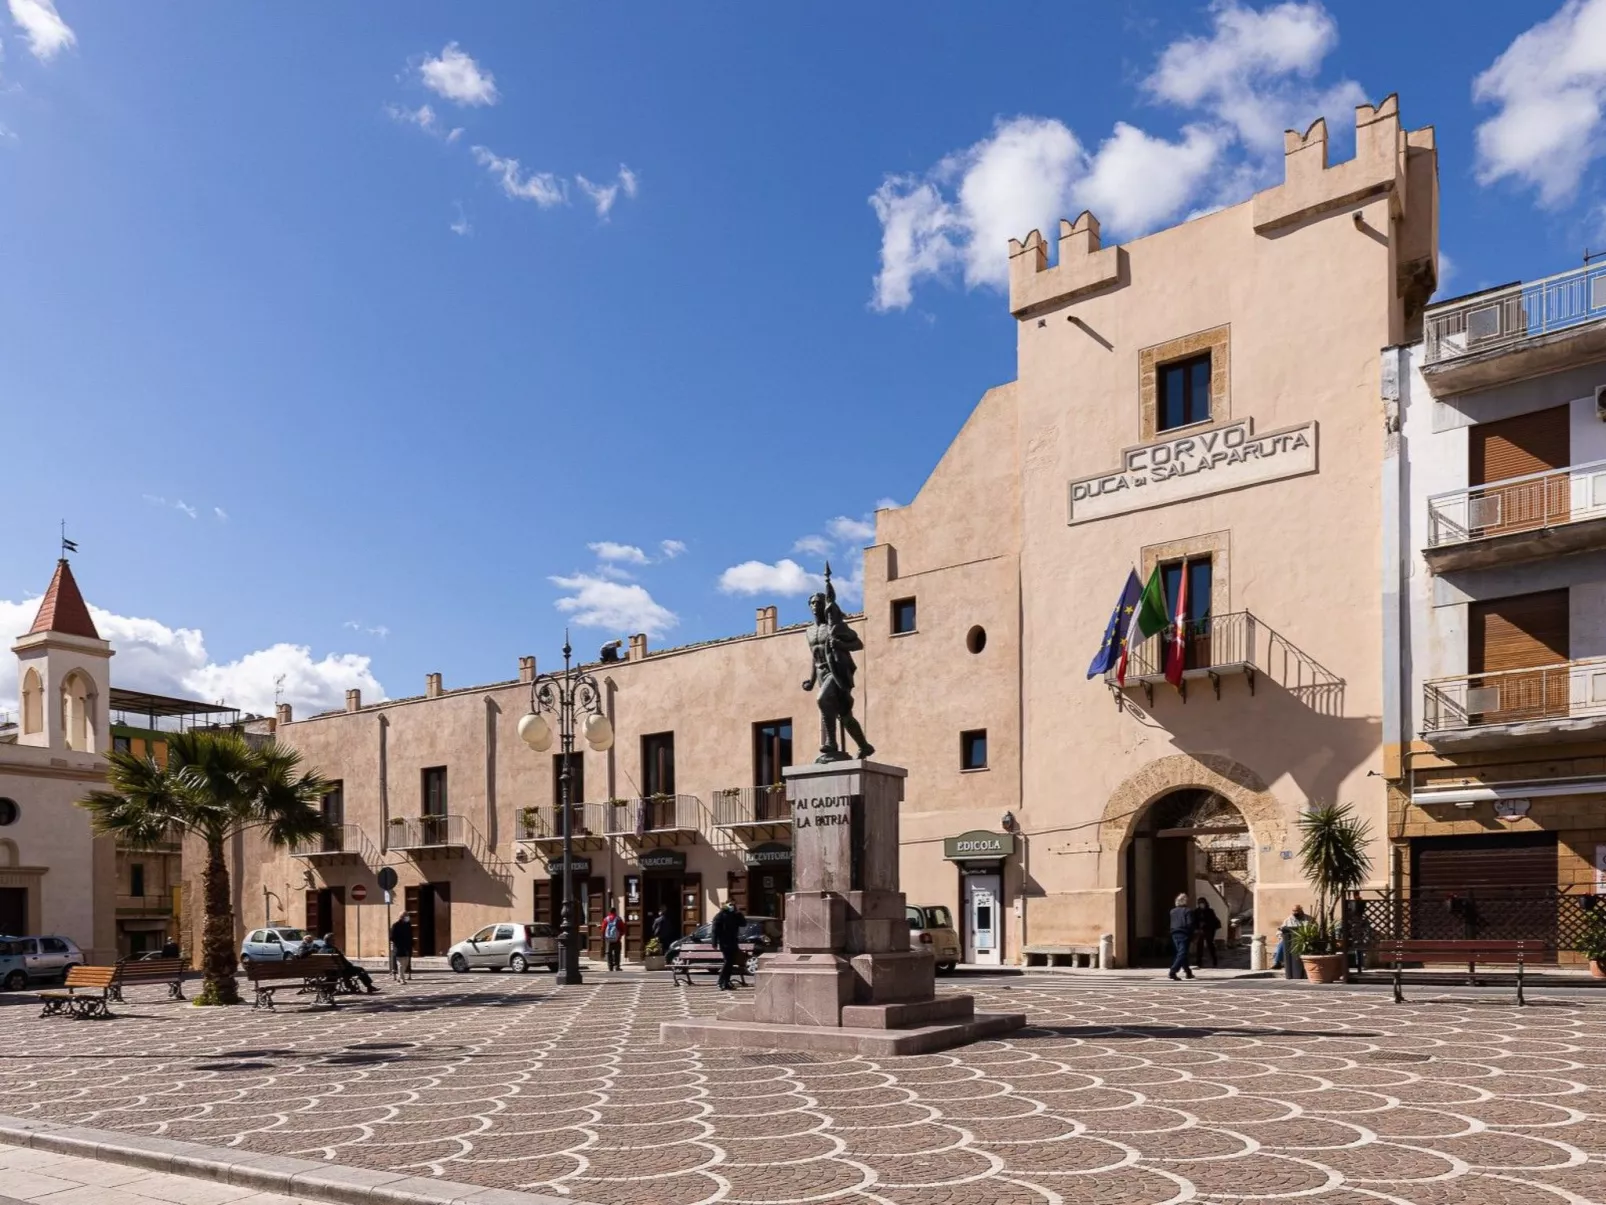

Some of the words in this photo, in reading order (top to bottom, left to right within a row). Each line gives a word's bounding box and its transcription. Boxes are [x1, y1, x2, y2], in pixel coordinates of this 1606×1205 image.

[1128, 427, 1246, 472] CORVO
[1072, 476, 1130, 501] DUCA
[1151, 433, 1309, 482] SALAPARUTA
[797, 798, 808, 810] AI
[797, 817, 811, 829] LA
[815, 814, 850, 826] PATRIA
[957, 840, 1001, 852] EDICOLA
